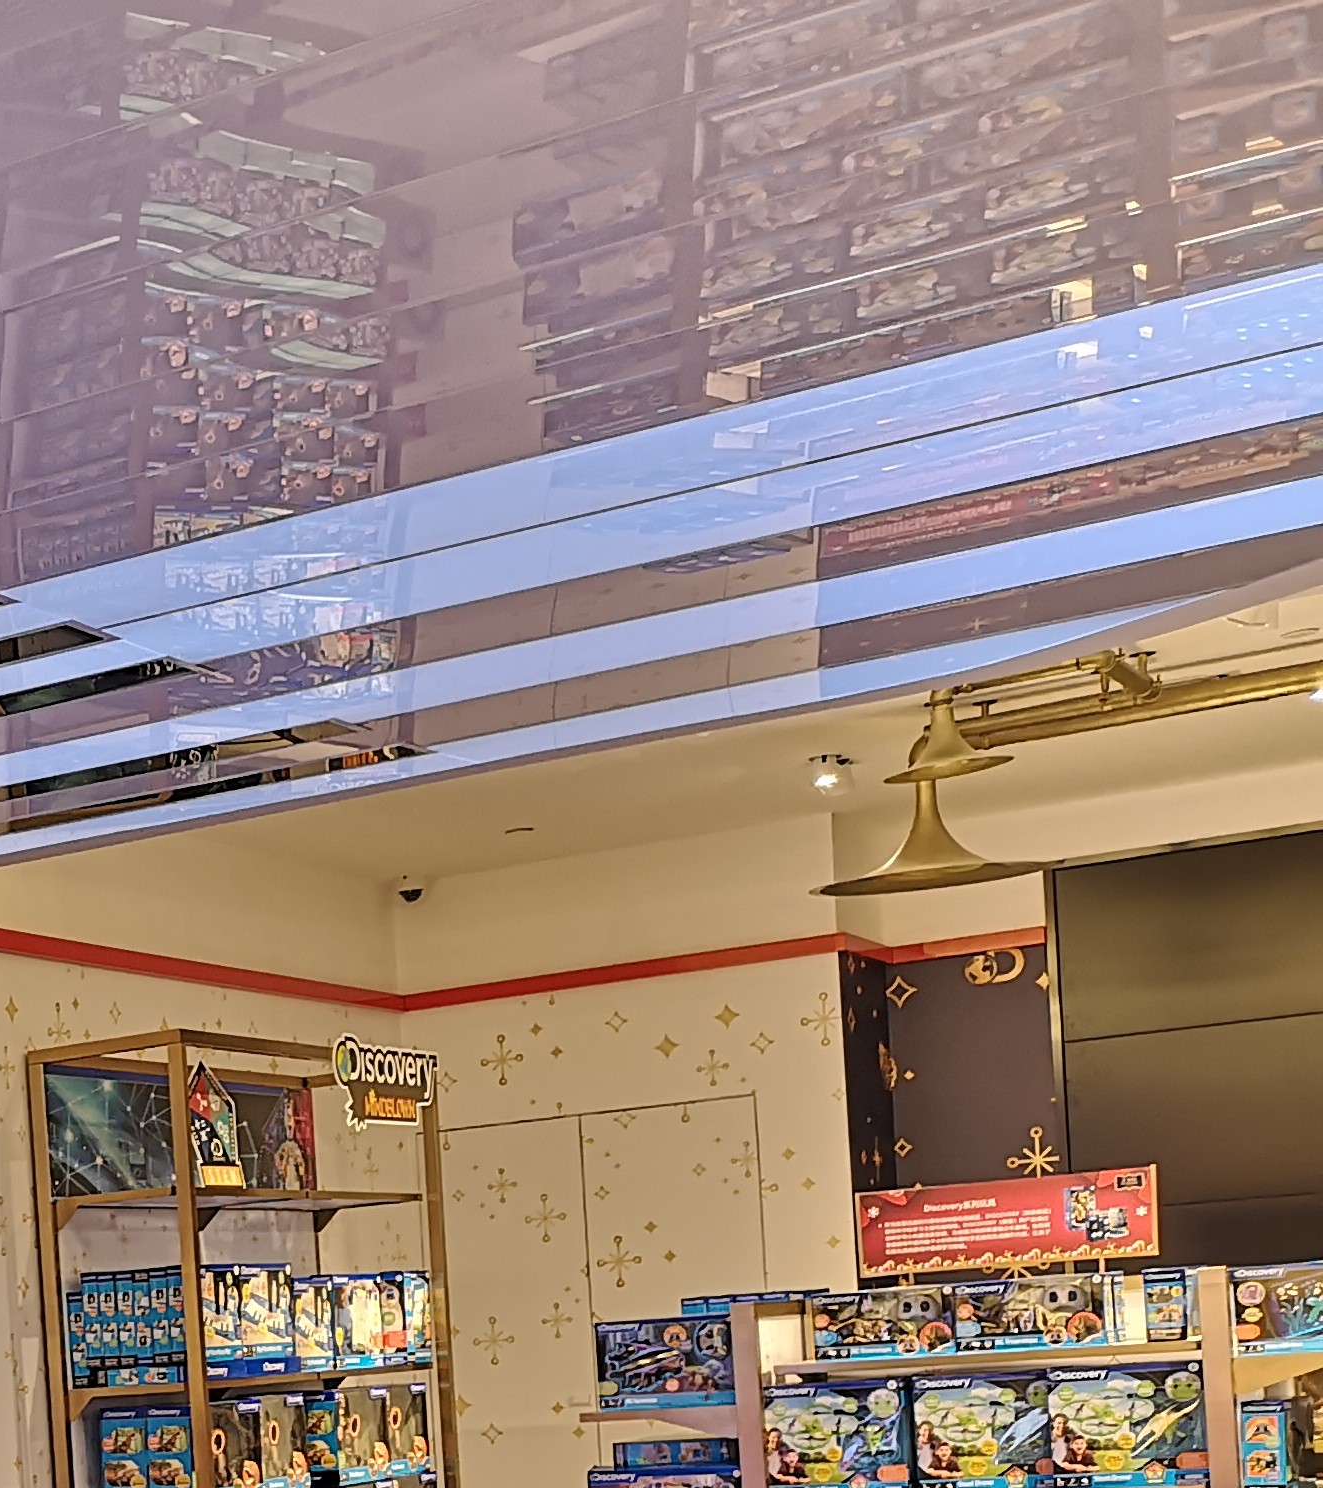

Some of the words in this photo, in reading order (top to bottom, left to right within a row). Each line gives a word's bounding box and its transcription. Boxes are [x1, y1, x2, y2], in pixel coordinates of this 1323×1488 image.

[337, 1040, 435, 1100] Discovery
[1054, 1369, 1107, 1381] Discovery
[916, 1378, 971, 1390] Discovery
